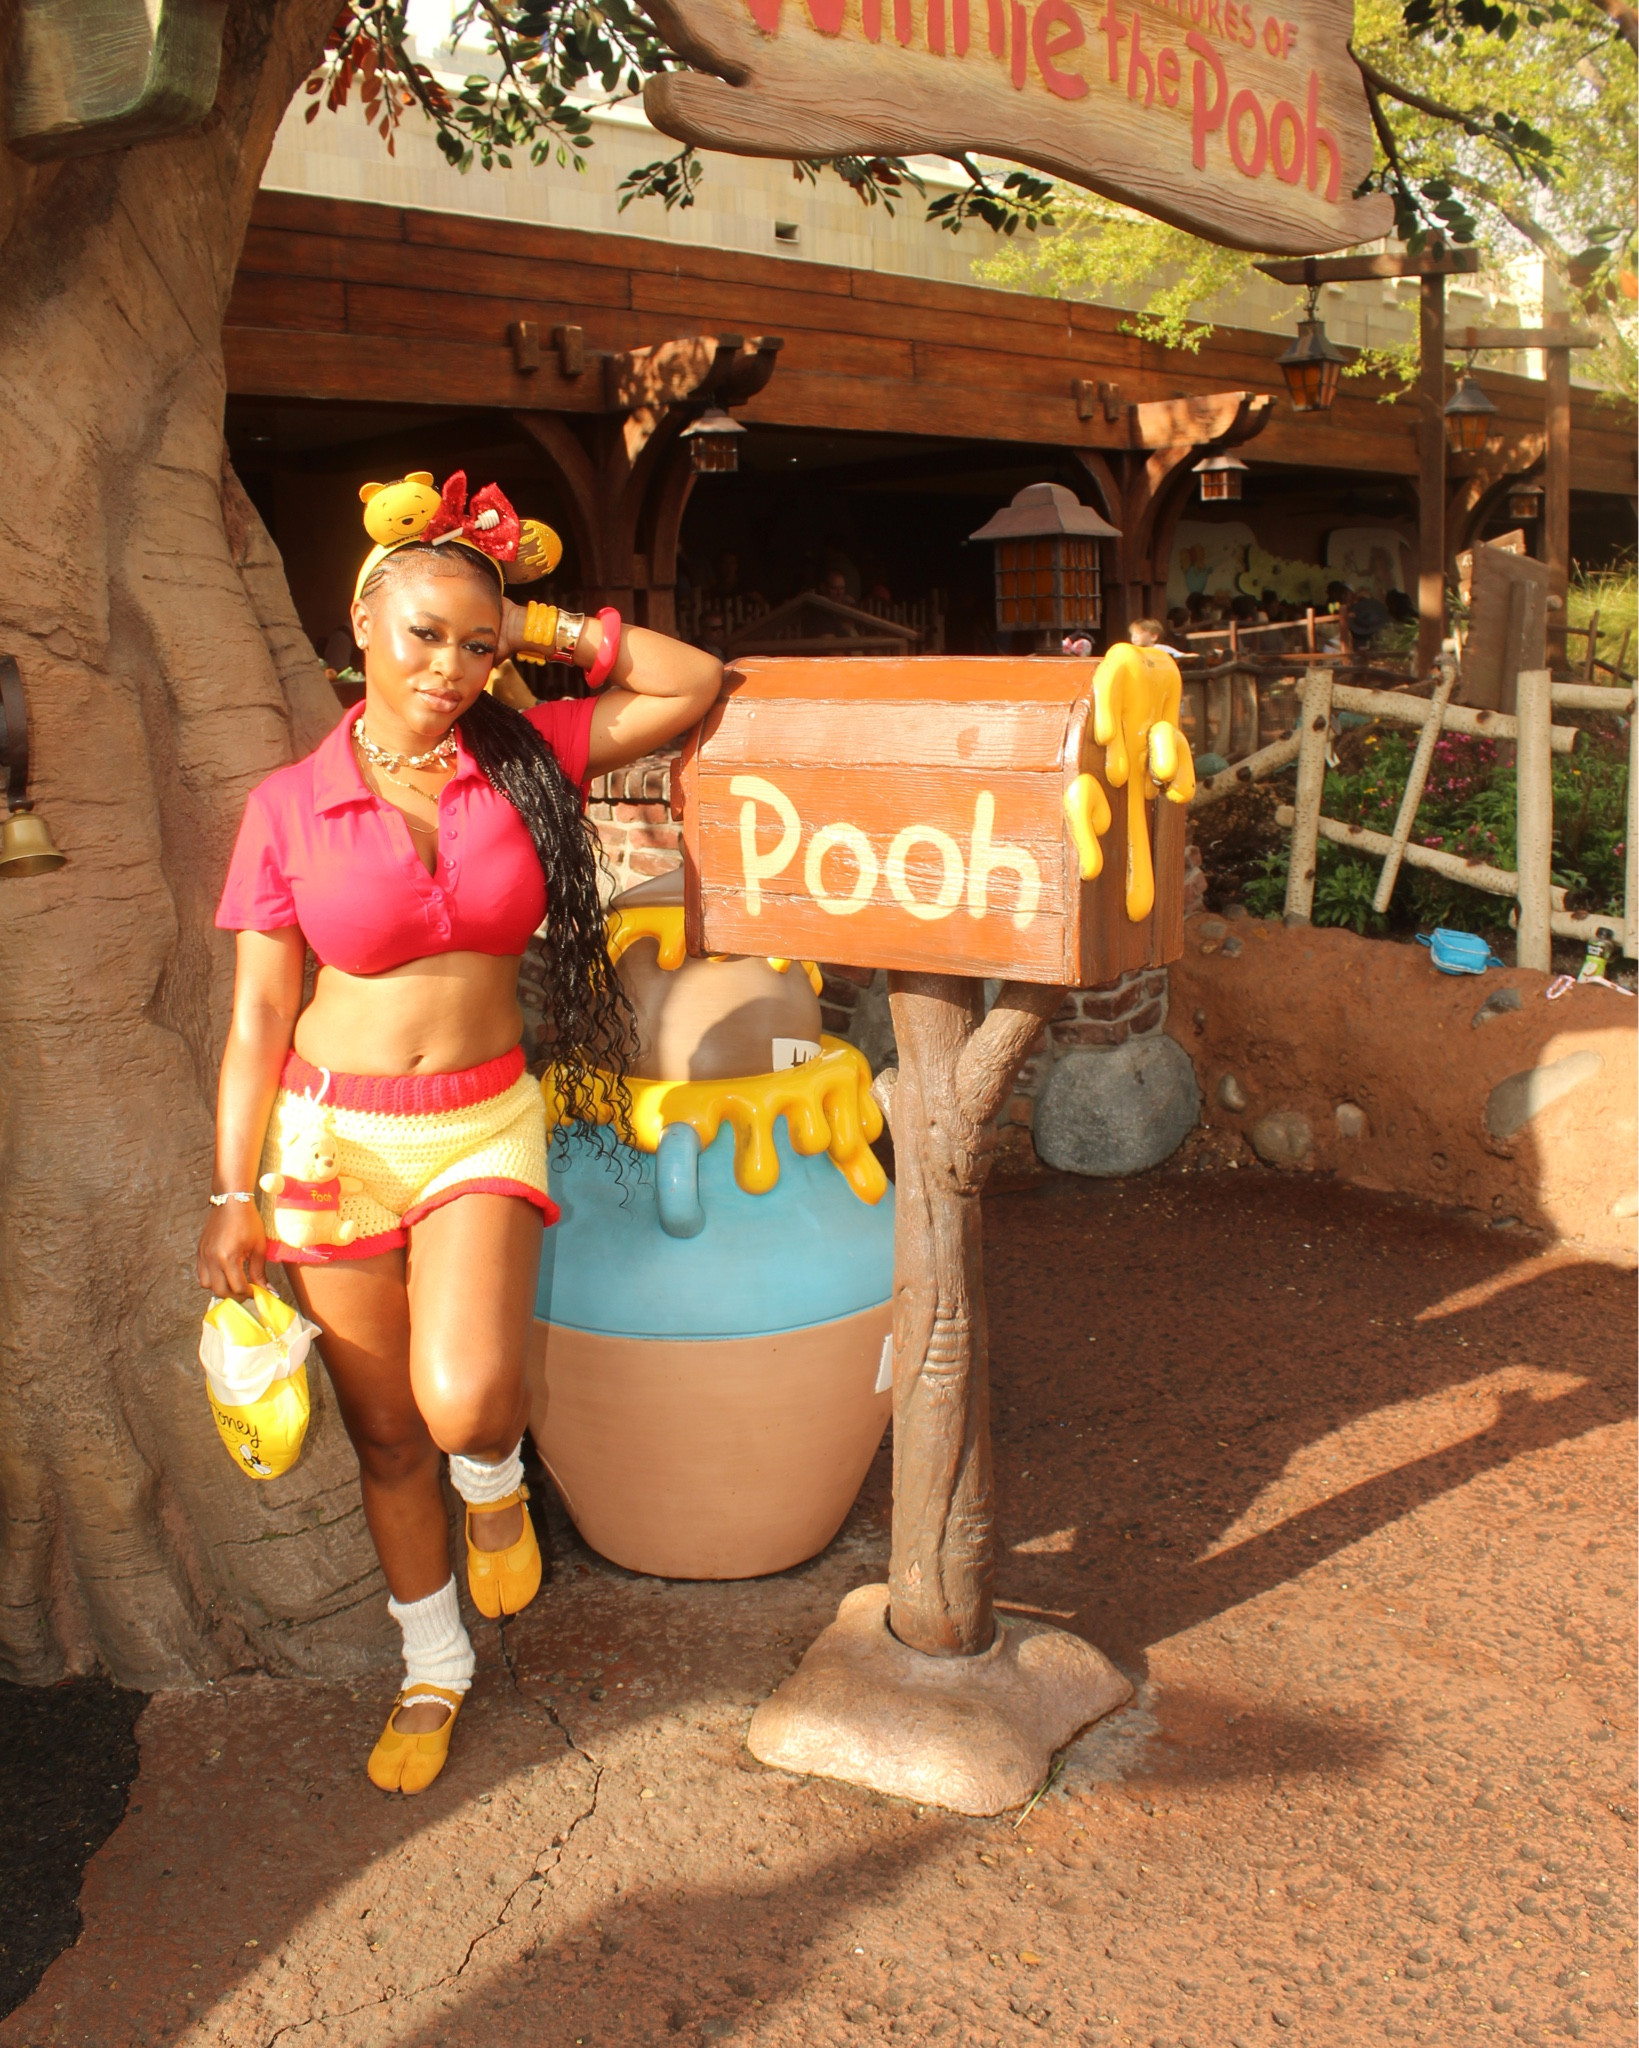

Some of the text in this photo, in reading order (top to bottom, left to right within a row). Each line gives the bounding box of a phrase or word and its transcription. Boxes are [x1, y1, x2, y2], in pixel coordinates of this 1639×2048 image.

[1100, 0, 1181, 108] the
[1186, 30, 1342, 203] Pooh
[1263, 16, 1299, 60] OF
[730, 775, 1041, 931] Pooh
